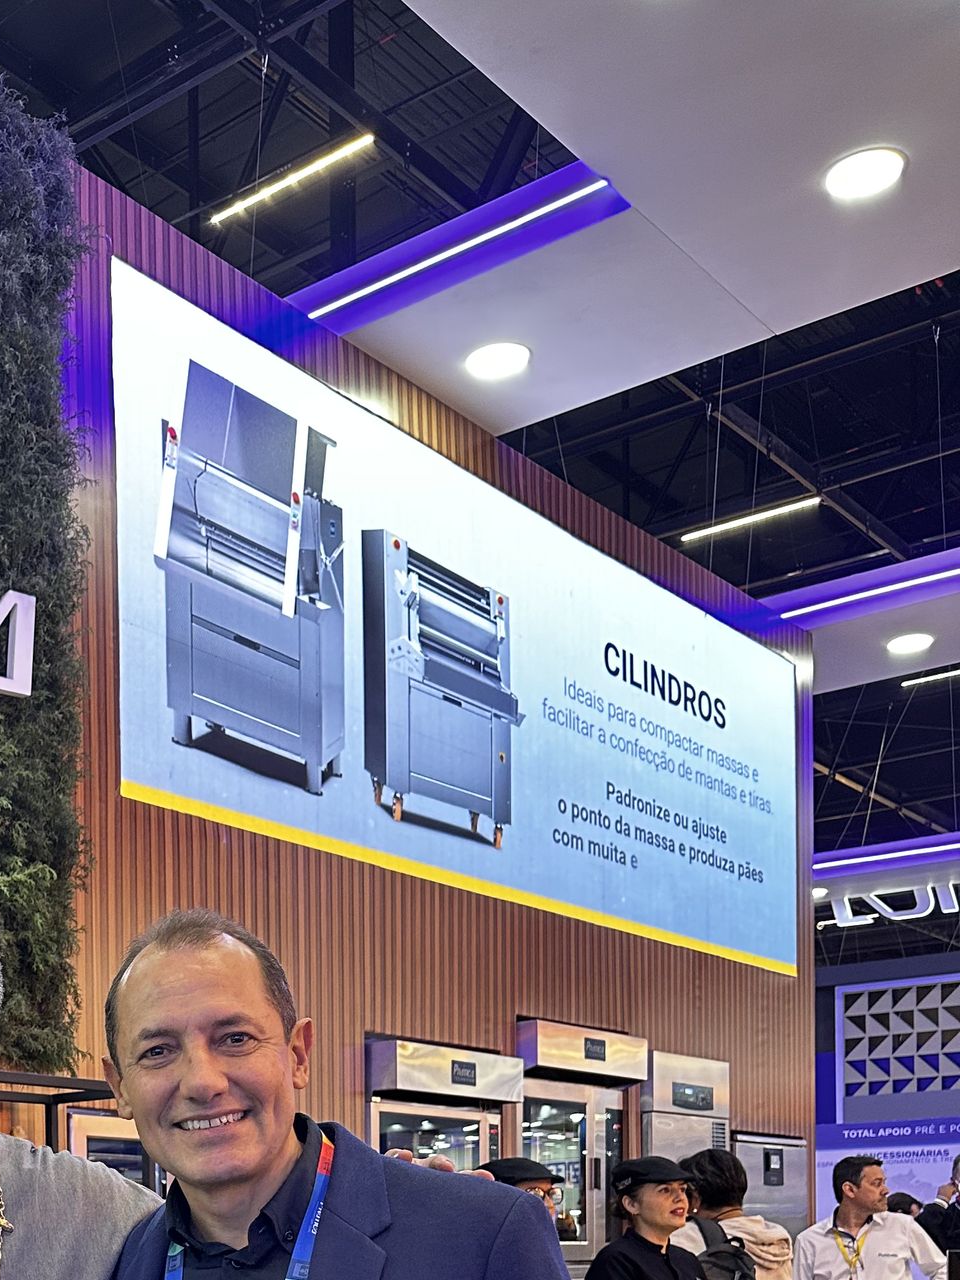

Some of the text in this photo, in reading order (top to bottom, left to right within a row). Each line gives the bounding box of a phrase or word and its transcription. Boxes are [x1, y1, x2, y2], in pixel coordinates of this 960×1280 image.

[603, 641, 727, 729] CILINDROS
[542, 699, 774, 815] facilitar a confecção de mantas e tiras.
[563, 676, 760, 783] Ideais para compactar massas e
[552, 827, 638, 869] com muita e
[558, 798, 764, 884] o ponto da massa e produza pães
[606, 781, 727, 844] Padronize ou ajuste
[842, 1128, 876, 1139] TOTAL
[878, 1126, 912, 1137] APOIO
[914, 1123, 936, 1135] PRÉ
[939, 1124, 946, 1134] E
